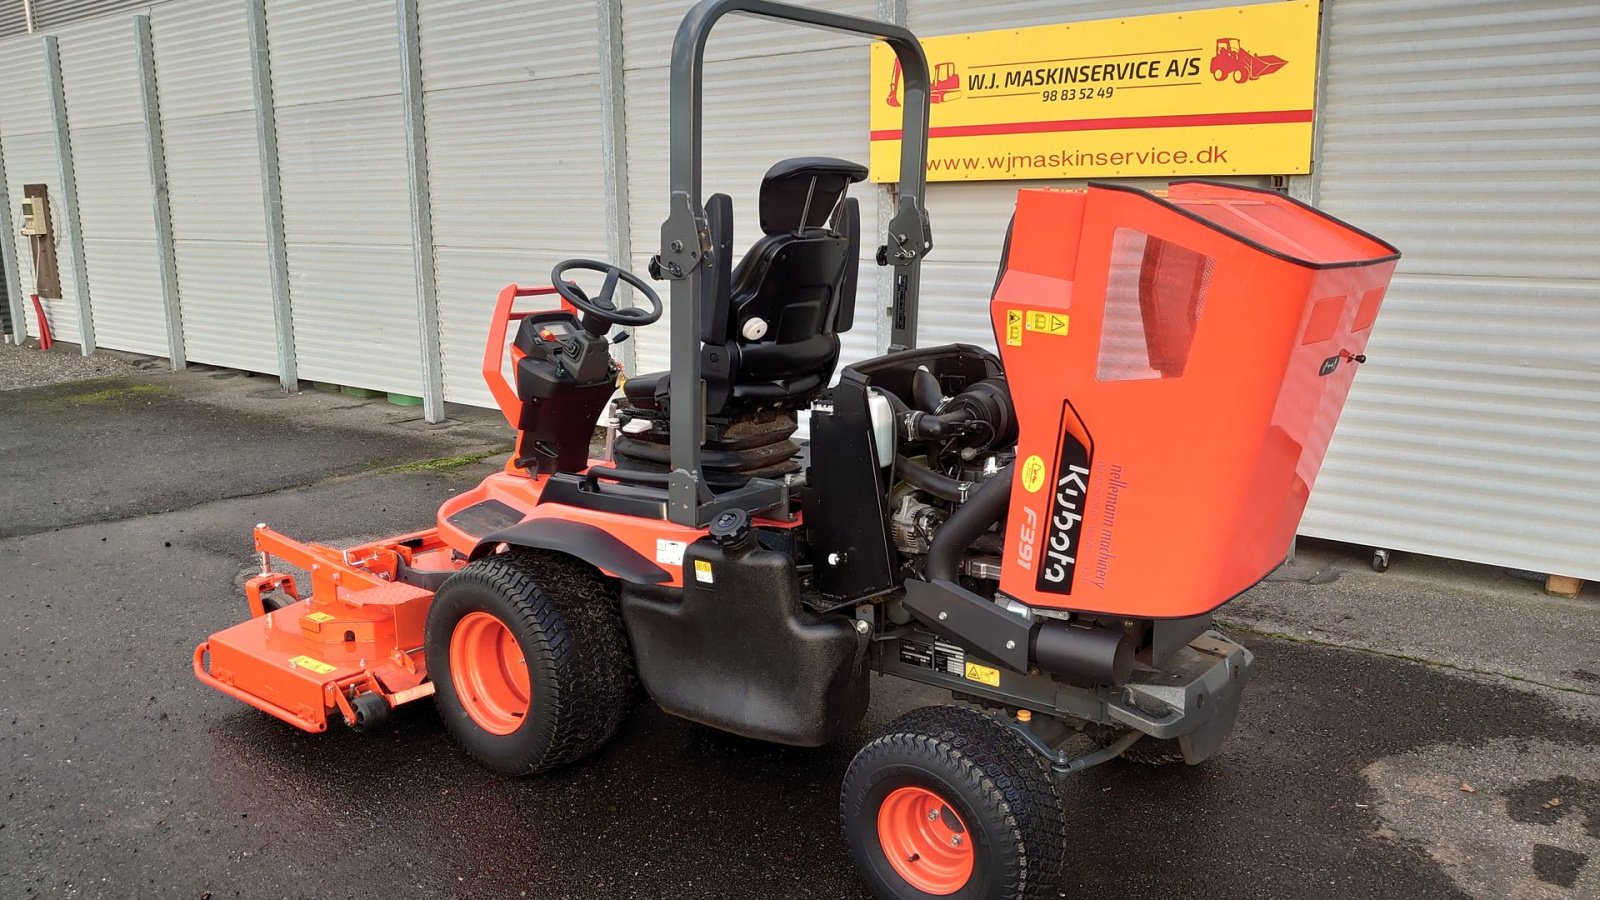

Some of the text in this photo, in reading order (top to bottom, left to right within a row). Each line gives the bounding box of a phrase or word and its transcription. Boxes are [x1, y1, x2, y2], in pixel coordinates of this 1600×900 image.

[968, 57, 1201, 91] W.J. MASKINSERVICE A/S
[1042, 86, 1114, 102] 98 83 52 49
[926, 145, 1229, 173] www.wjmaskinservice.dk
[1044, 464, 1090, 583] Kubota
[1103, 464, 1127, 526] nellemann
[1017, 506, 1037, 571] F391
[1091, 528, 1115, 589] machinery
